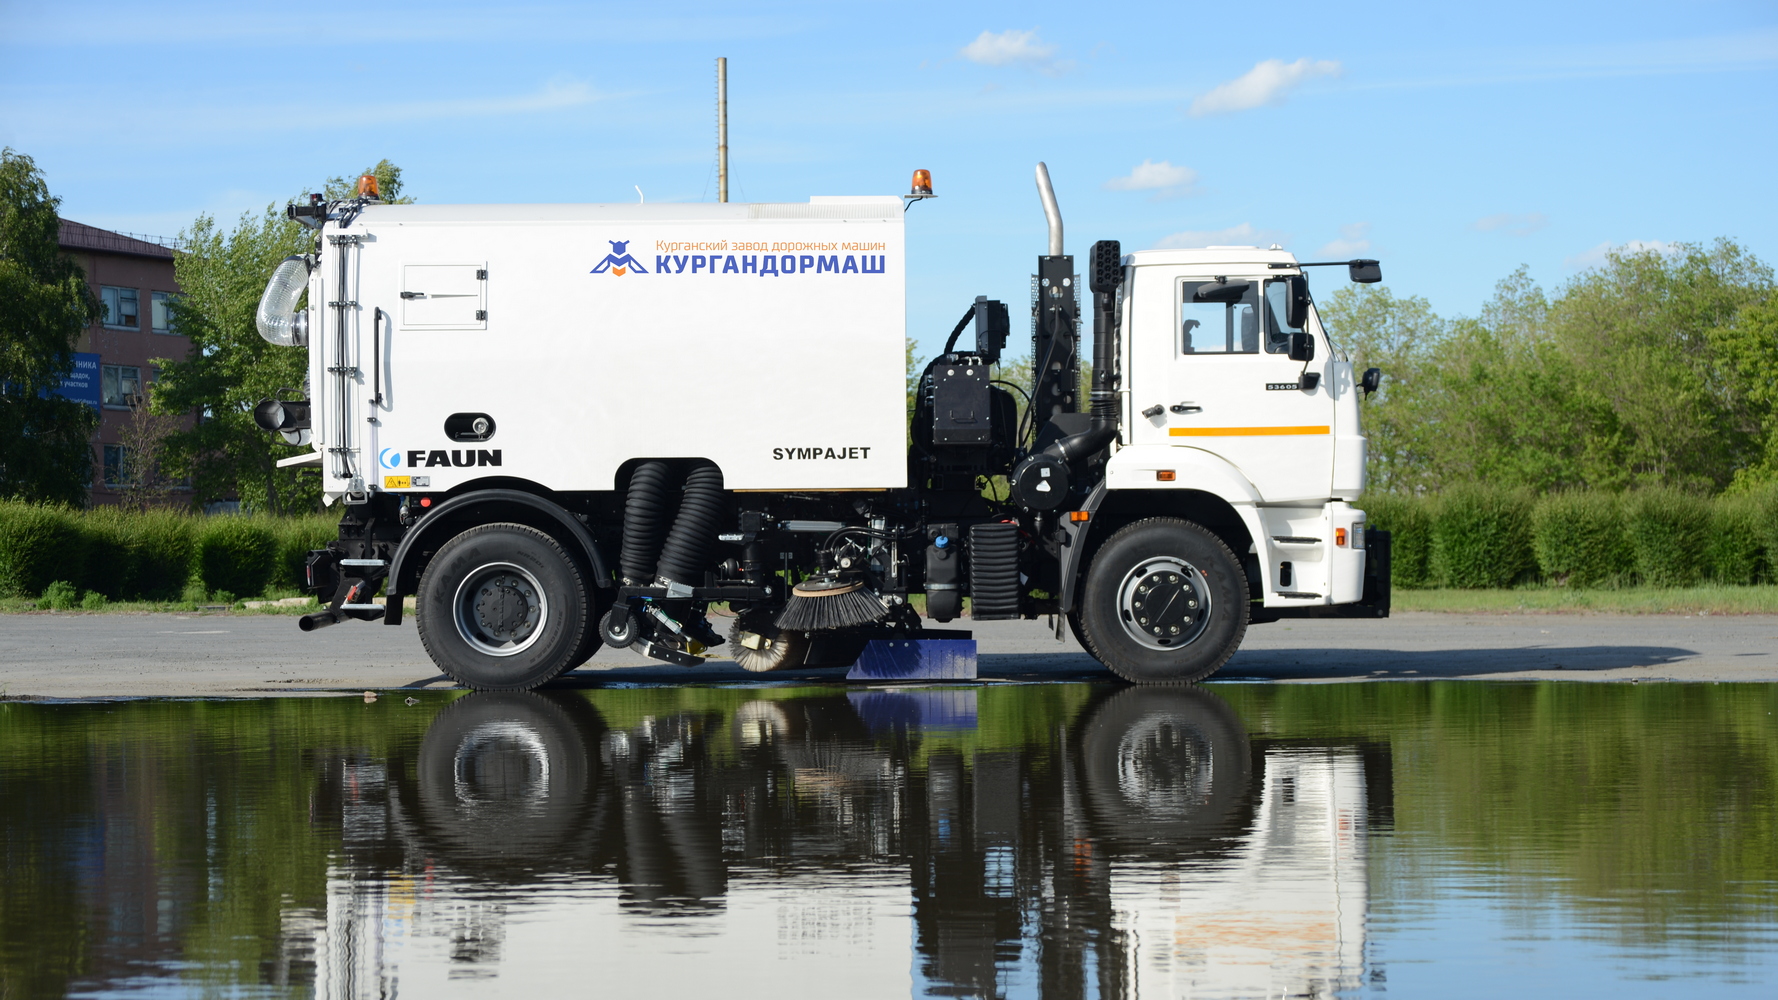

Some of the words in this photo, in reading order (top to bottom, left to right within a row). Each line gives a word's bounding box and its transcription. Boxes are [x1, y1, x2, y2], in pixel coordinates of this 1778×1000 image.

[656, 240, 727, 253] Курганский
[731, 242, 768, 252] завод
[771, 242, 838, 252] дорожных
[841, 242, 886, 251] машин
[656, 255, 886, 277] КУРГАНДОРМАШ
[407, 449, 502, 468] FAUN
[772, 447, 871, 460] SYMPAJET
[434, 547, 482, 604] KAMA
[1203, 555, 1233, 622] KAMA
